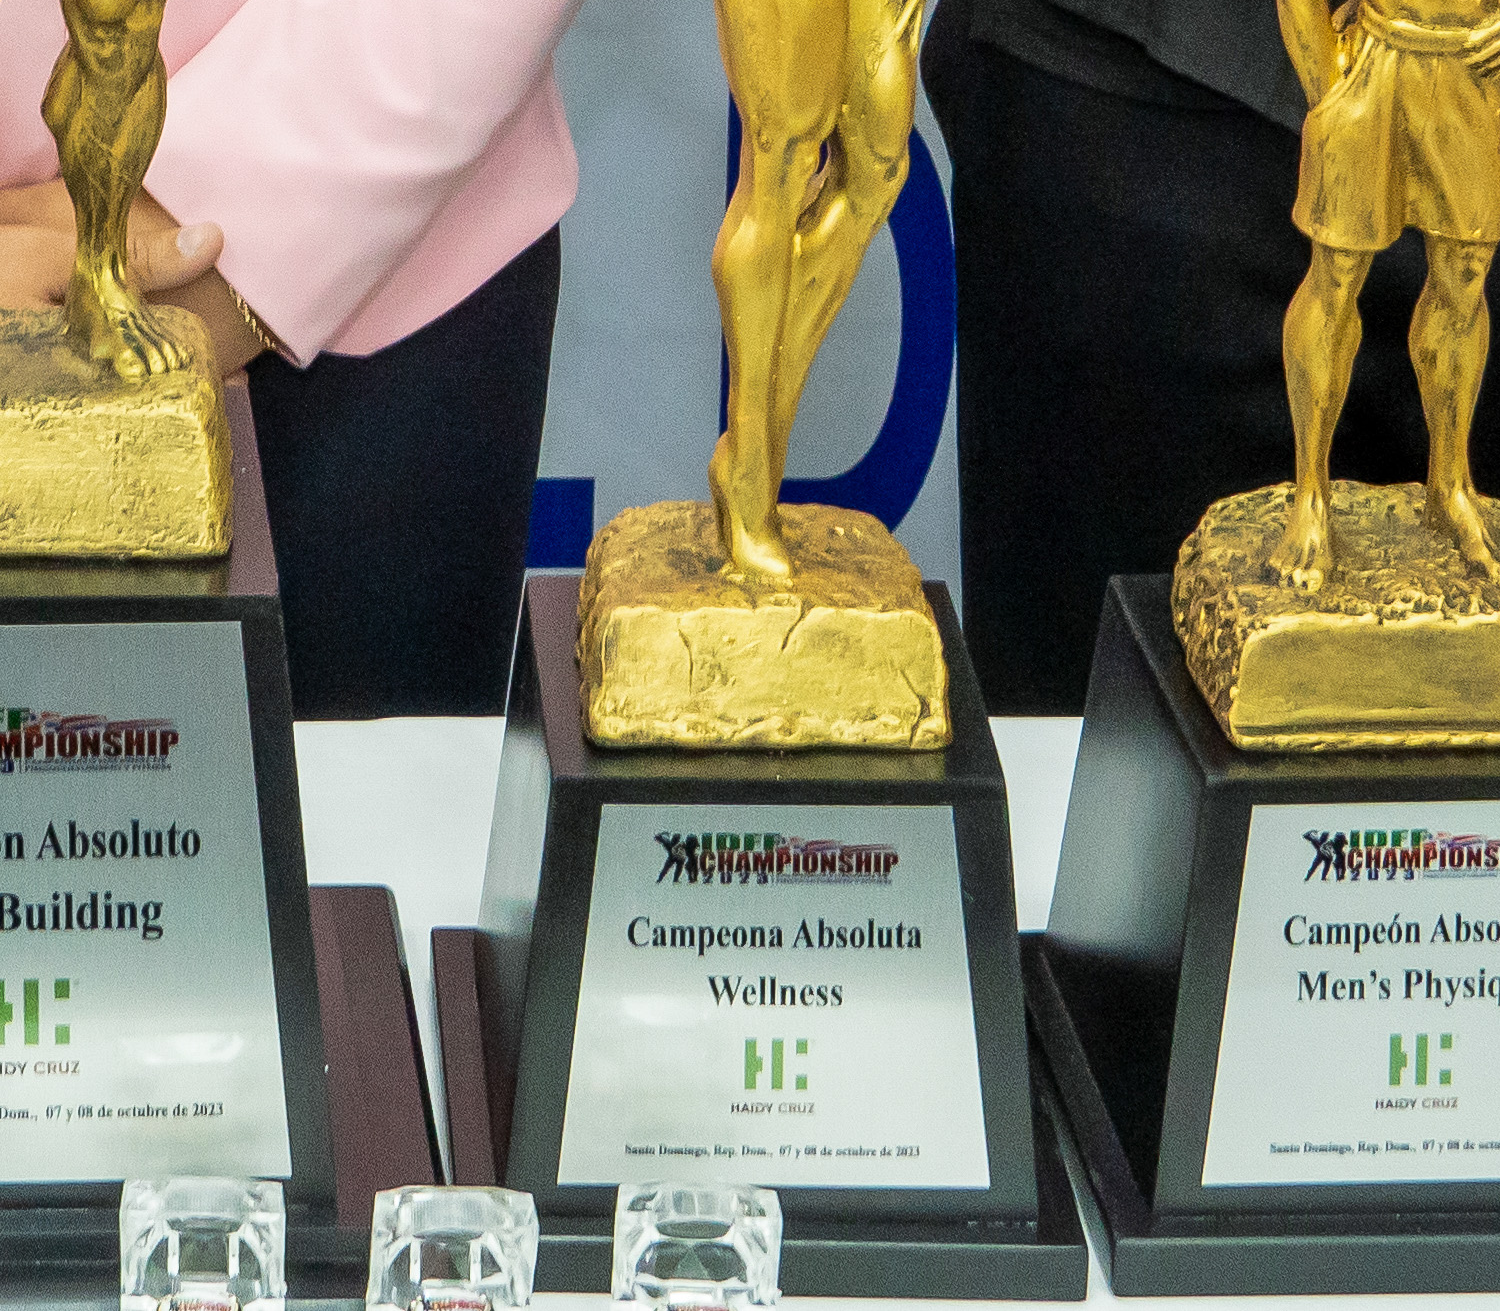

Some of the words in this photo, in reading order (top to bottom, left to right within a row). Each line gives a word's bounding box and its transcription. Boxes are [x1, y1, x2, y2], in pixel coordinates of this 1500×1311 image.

[37, 819, 201, 859] Absoluto
[699, 850, 898, 875] CHAMPIONSHIP
[626, 916, 783, 957] Campeona
[792, 918, 922, 950] Absoluta
[1284, 913, 1420, 953] Campeón
[707, 975, 844, 1007] Wellness
[46, 1104, 62, 1119] 07
[77, 1104, 94, 1119] 08
[97, 1104, 113, 1119] de
[117, 1103, 168, 1118] octubre
[172, 1103, 188, 1118] de
[192, 1102, 223, 1117] 2023
[731, 1102, 773, 1114] HAIDY
[1375, 1098, 1417, 1109] HAIDY
[779, 1145, 792, 1157] 07
[804, 1145, 817, 1157] 08
